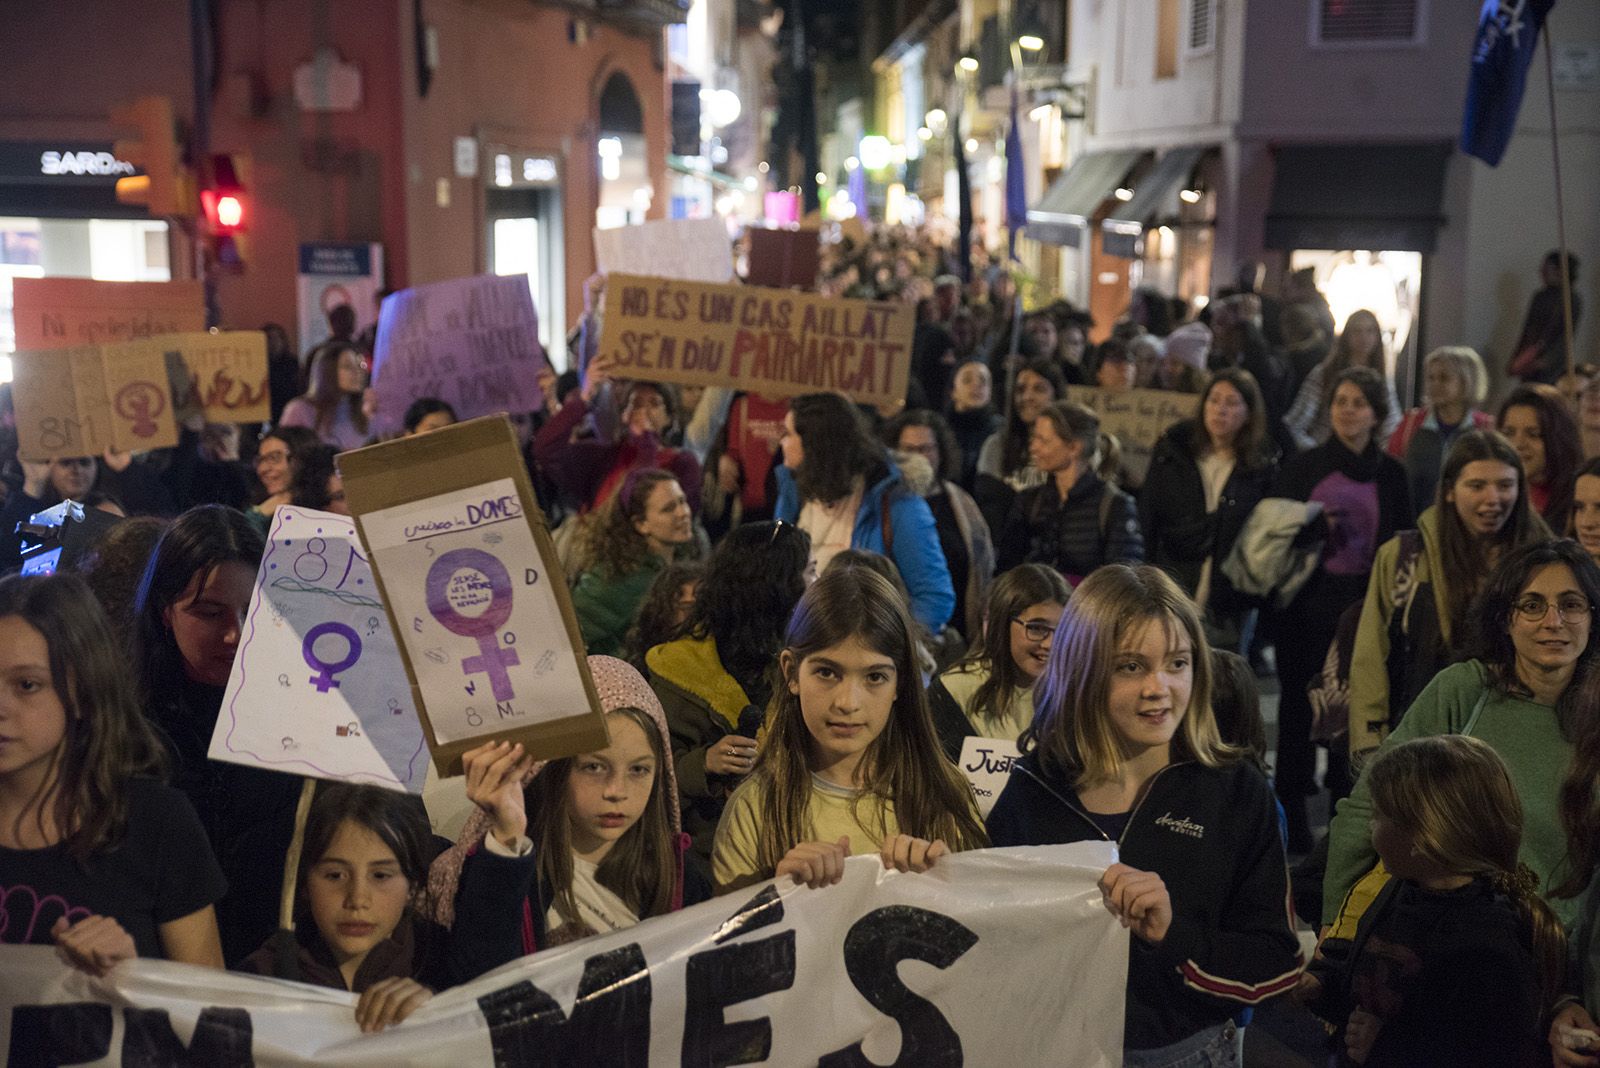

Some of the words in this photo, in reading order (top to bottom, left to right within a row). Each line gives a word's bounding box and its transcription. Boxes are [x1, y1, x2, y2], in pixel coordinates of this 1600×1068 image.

[621, 286, 648, 316] NO
[655, 281, 690, 321] ÉS
[699, 291, 734, 323] UN
[740, 295, 793, 329] CAS
[466, 495, 521, 525] DONES
